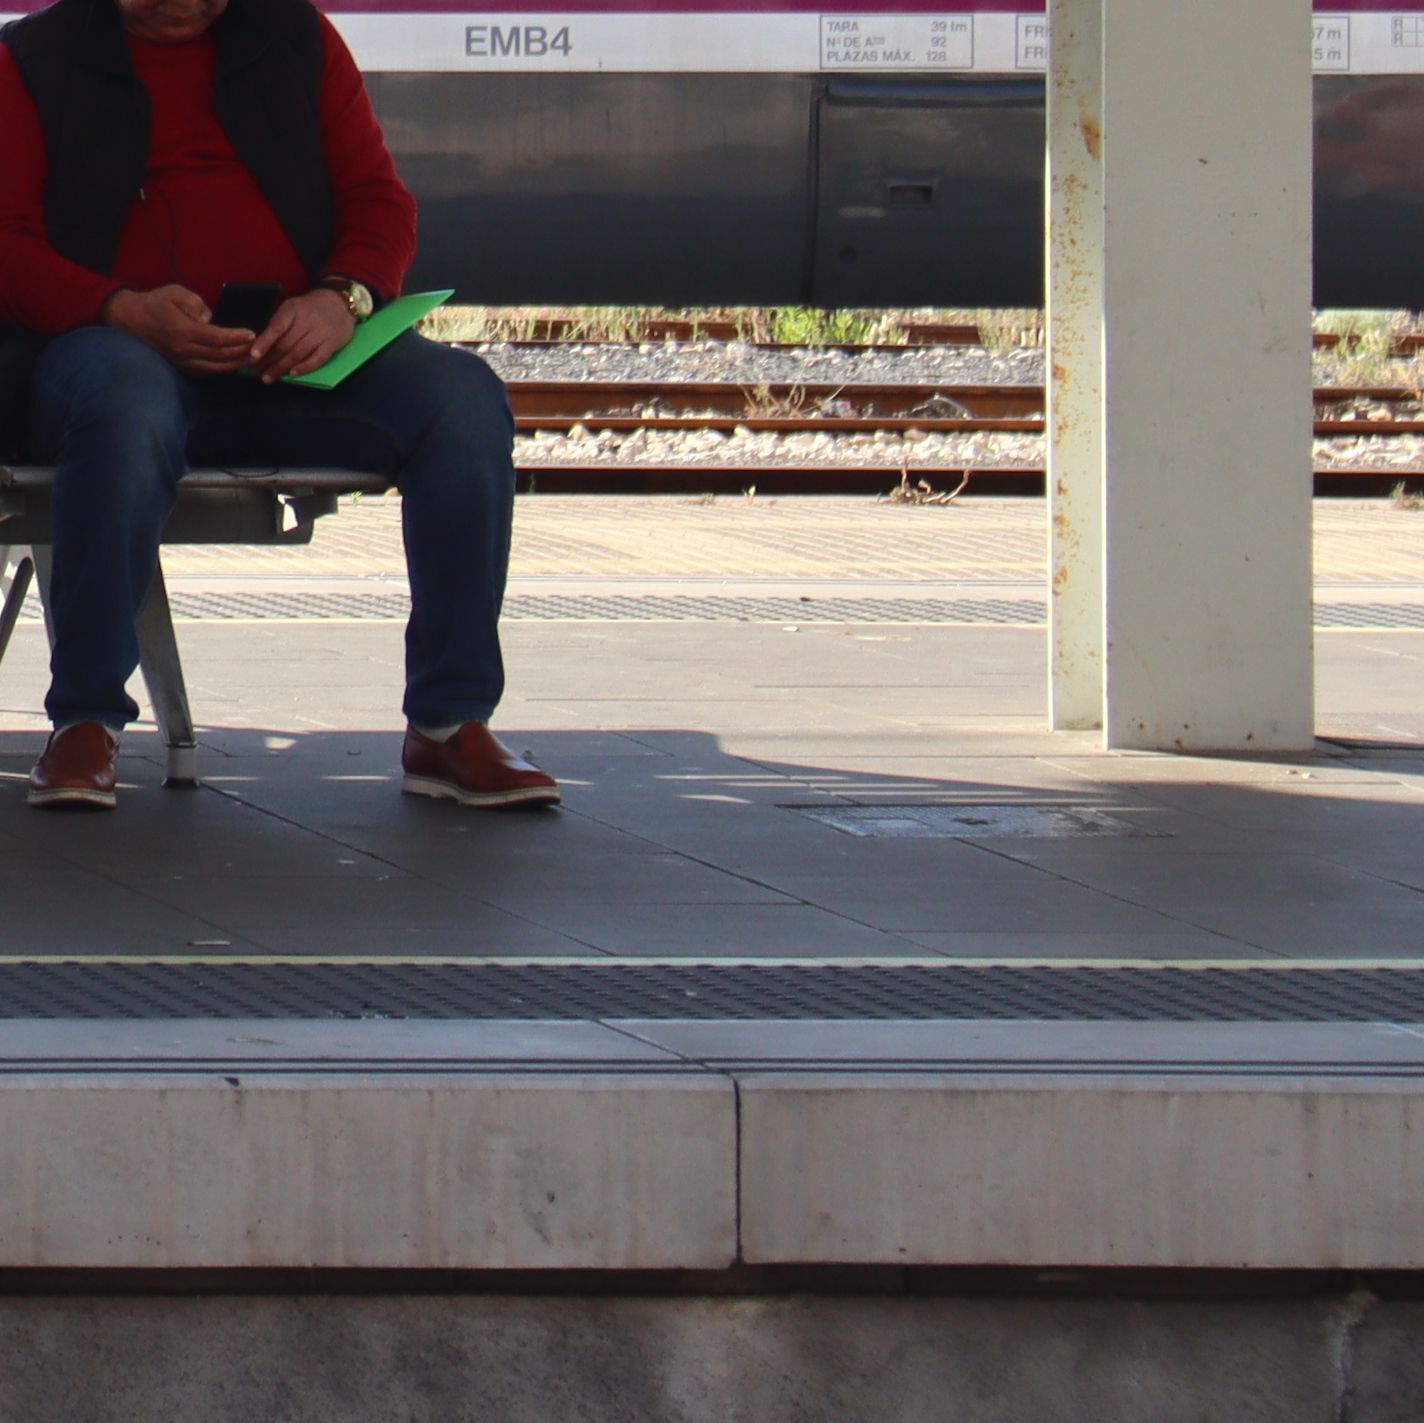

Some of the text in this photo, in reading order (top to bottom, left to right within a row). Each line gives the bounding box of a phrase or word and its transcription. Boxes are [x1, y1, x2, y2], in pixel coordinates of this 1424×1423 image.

[827, 22, 859, 32] TARA
[931, 22, 947, 32] 39
[1327, 30, 1341, 40] m
[465, 26, 573, 57] EMB4
[844, 37, 861, 47] DE
[931, 37, 947, 47] 92
[827, 52, 878, 62] PLAZAS
[926, 51, 947, 62] 128
[1327, 50, 1341, 60] m
